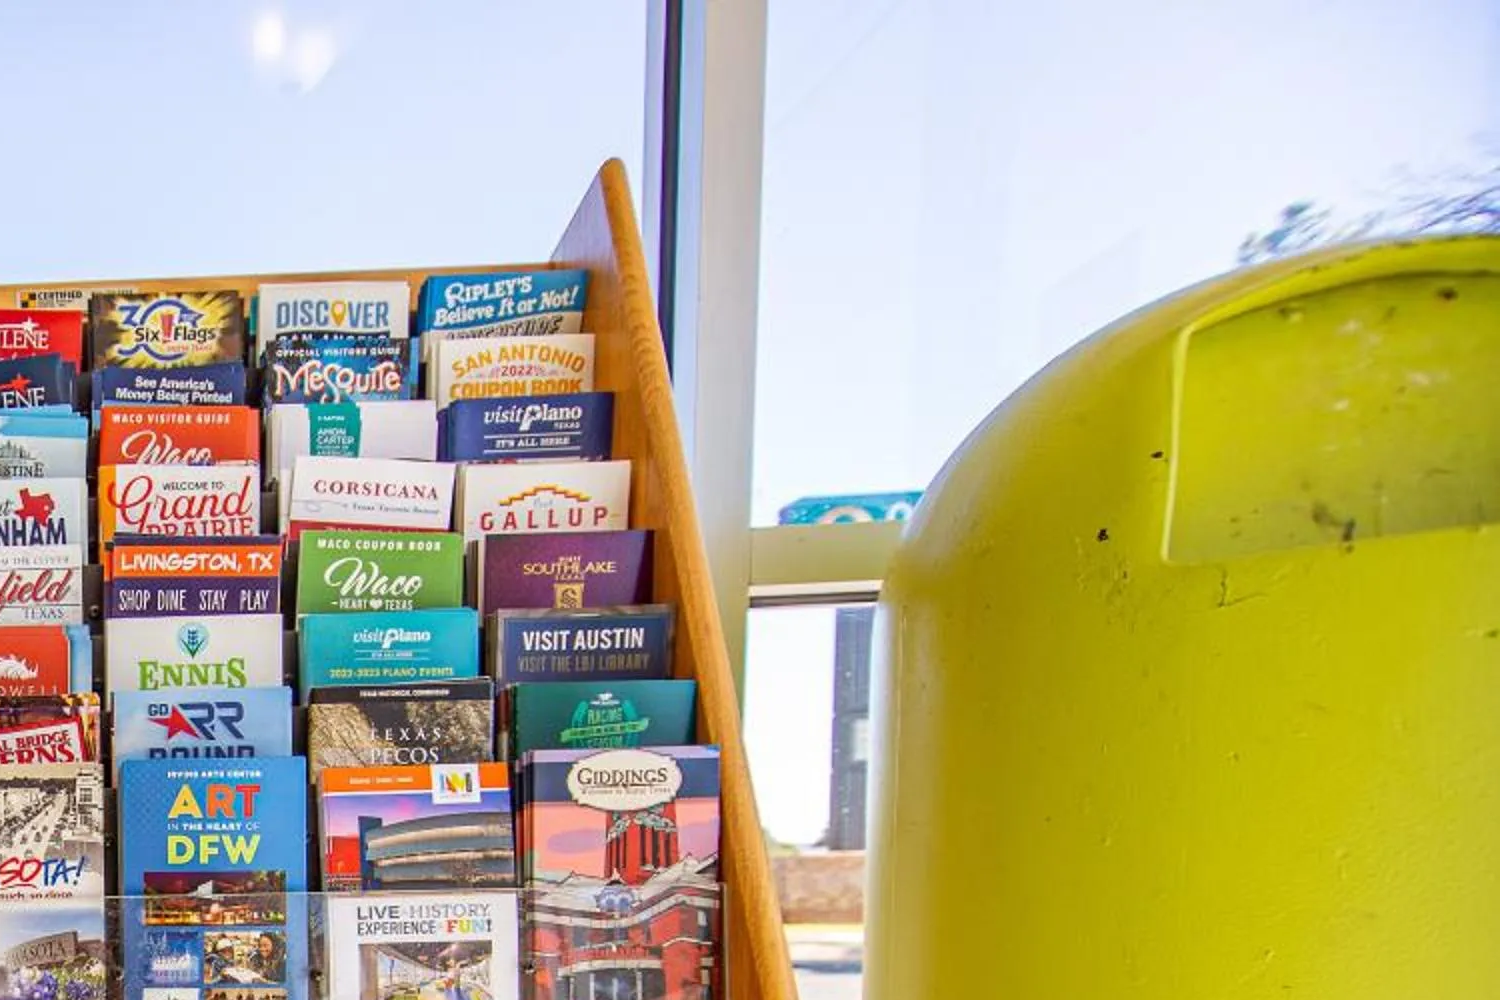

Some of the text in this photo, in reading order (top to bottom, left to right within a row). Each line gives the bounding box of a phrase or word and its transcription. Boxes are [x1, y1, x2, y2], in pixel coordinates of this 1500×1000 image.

[446, 276, 532, 307] RIPLEY'S
[276, 300, 388, 328] DISCOVER
[434, 286, 579, 326] Believe It or Not!
[135, 325, 216, 342] Six Flags
[452, 344, 585, 378] SAN ANTONIO
[136, 376, 214, 390] See America's
[450, 378, 583, 399] COUPON BOOK
[116, 388, 232, 403] Money Being Printed
[112, 414, 142, 424] WACO
[148, 414, 192, 424] VISITOR
[121, 430, 212, 464] Waco
[518, 438, 538, 447] ALL
[162, 482, 208, 490] WELCOME
[314, 479, 438, 499] CORSICANA
[108, 475, 253, 534] Grand
[479, 507, 608, 531] GALLUP
[317, 539, 351, 550] WACO
[355, 540, 404, 551] COUPON
[120, 553, 274, 572] LIVINGSTON, TX
[523, 561, 617, 575] SOUTHLAKE
[324, 557, 423, 597] Waco
[119, 589, 269, 611] SHOP DINE STAY PLAY
[23, 607, 65, 619] TEXAS
[523, 628, 645, 651] VISIT AUSTIN
[138, 657, 248, 690] ENNIS
[148, 703, 169, 717] GO
[15, 730, 72, 750] BRIDGE
[371, 727, 442, 741] TEXAS
[370, 746, 440, 764] PECOS
[577, 767, 668, 785] GIDDINGS
[167, 783, 261, 819] ART
[167, 835, 261, 864] DFW
[357, 905, 401, 920] LIVE
[357, 919, 492, 936] EXPERIENCE FUN!
